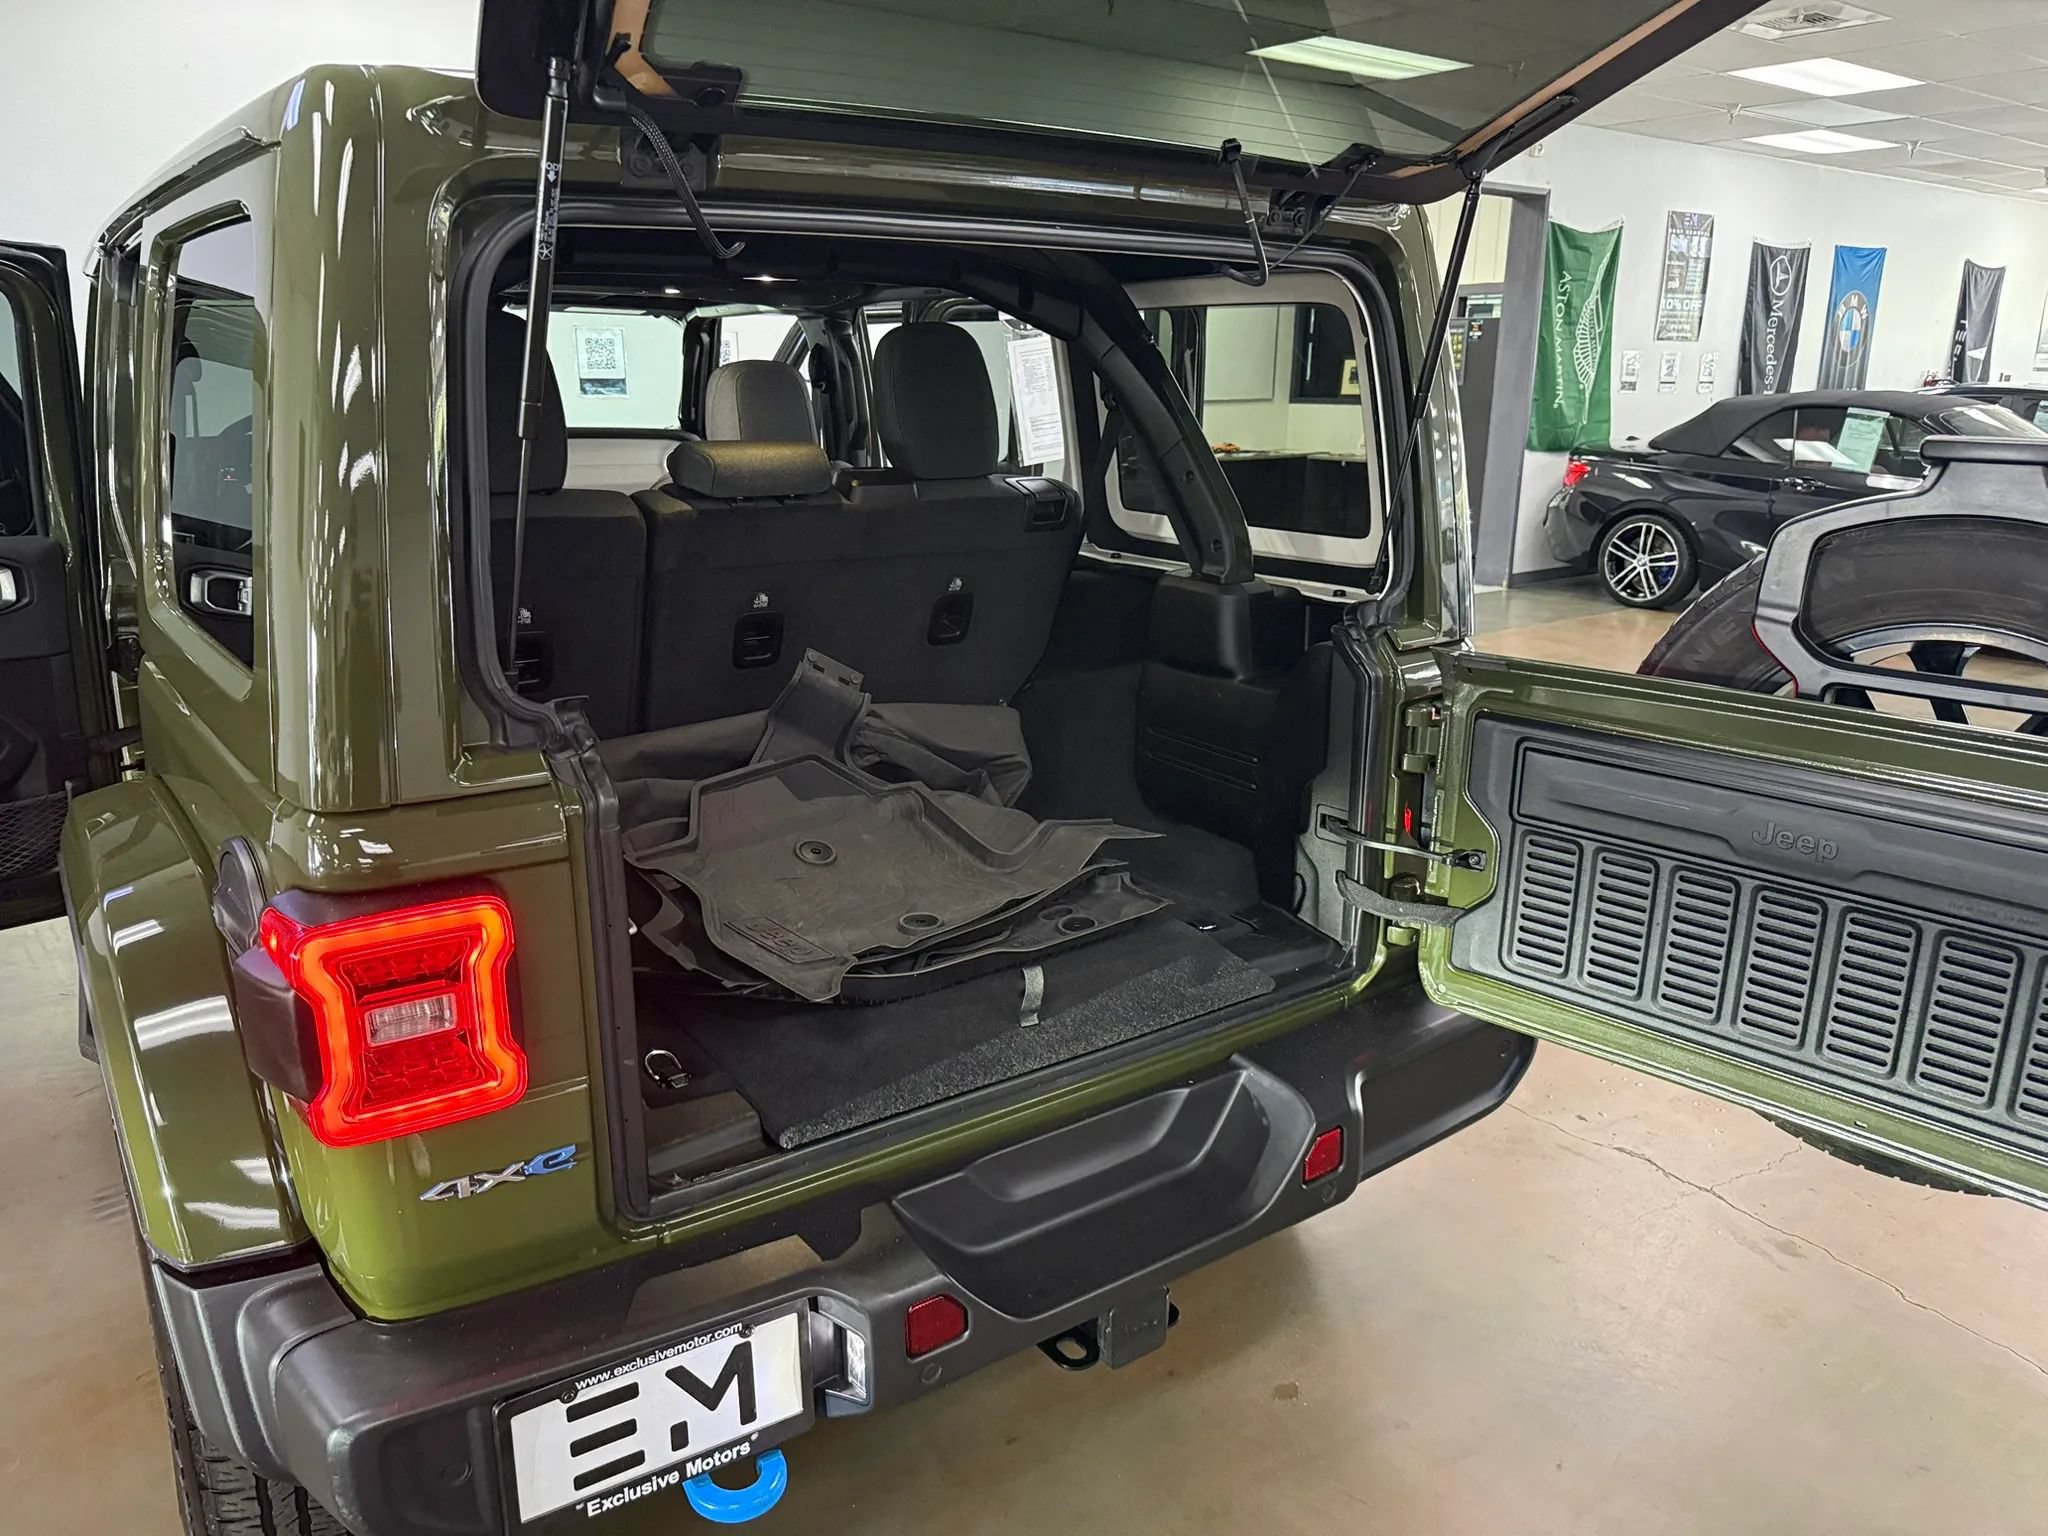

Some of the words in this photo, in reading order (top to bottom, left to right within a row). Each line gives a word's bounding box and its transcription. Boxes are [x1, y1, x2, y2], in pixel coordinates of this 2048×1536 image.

[1555, 270, 1573, 332] ASTON
[1837, 295, 1869, 319] BMW
[1752, 820, 1839, 863] Jeep
[574, 1321, 743, 1391] www.exclusivemotor.com
